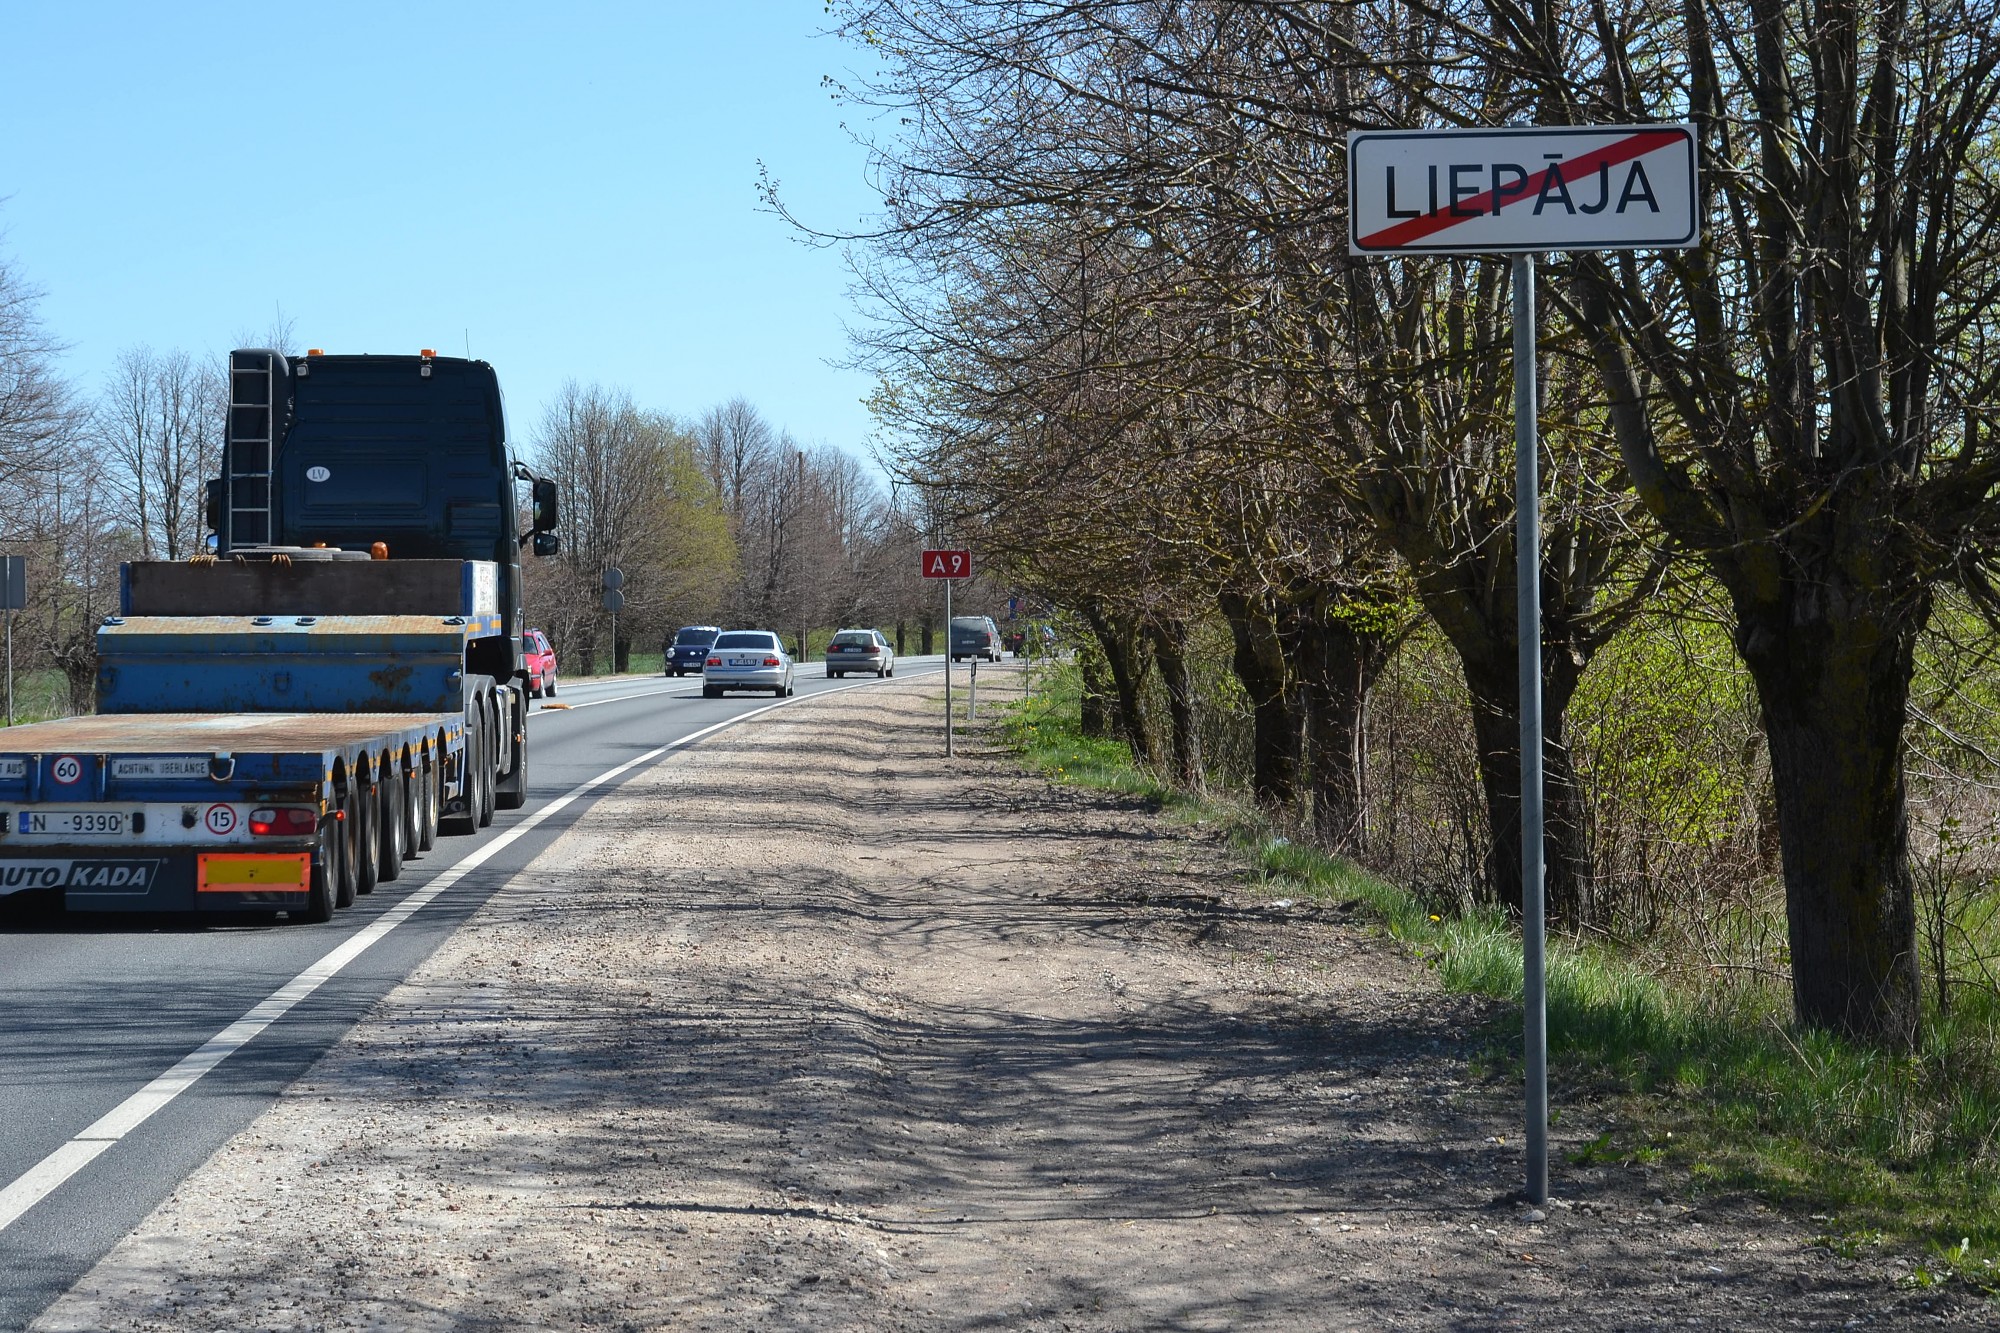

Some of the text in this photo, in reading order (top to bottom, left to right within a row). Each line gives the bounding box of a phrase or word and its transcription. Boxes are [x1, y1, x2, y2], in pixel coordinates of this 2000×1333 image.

[1386, 153, 1660, 219] LIEPĀJA
[312, 469, 325, 480] LV
[57, 765, 78, 778] 60
[212, 811, 230, 827] 15
[70, 867, 147, 886] KADA
